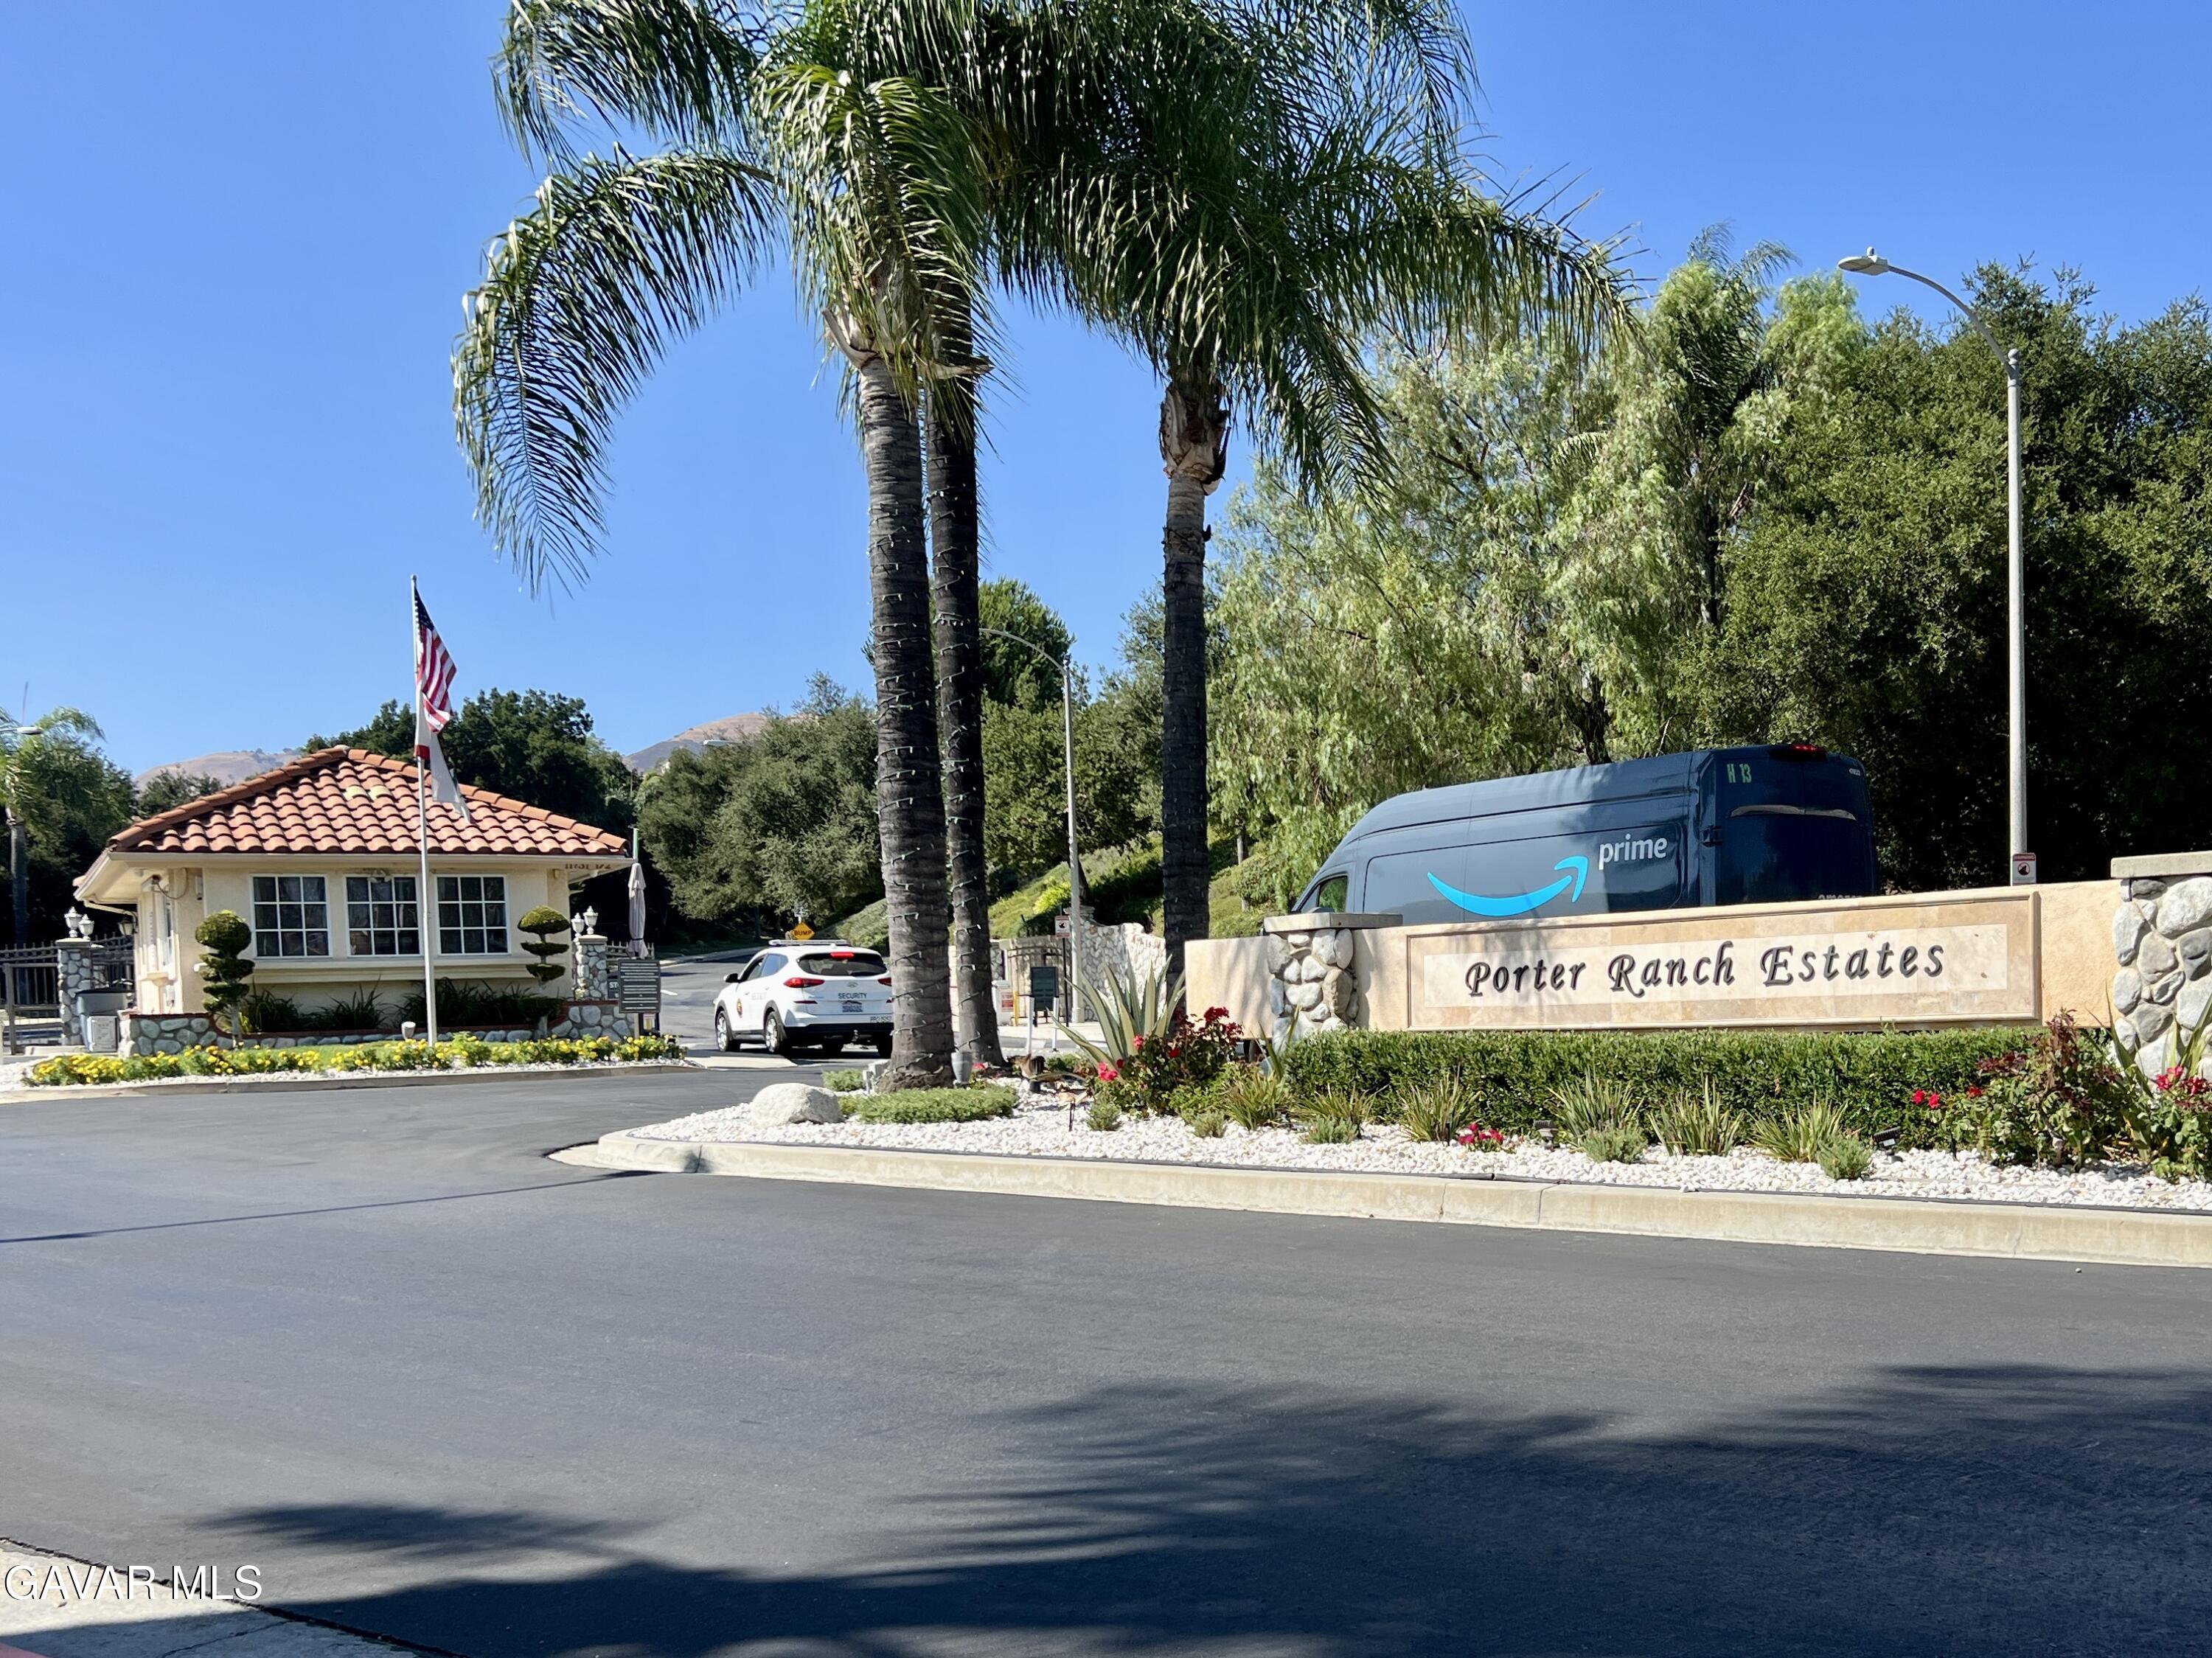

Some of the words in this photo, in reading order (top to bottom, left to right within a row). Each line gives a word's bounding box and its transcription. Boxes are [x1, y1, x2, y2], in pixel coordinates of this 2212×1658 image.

[1727, 763, 1736, 783] H
[1739, 763, 1752, 783] 13
[1599, 833, 1668, 870] prime
[1465, 958, 1586, 997] Porter
[1607, 940, 1735, 998] Ranch
[1759, 941, 1944, 987] Estates
